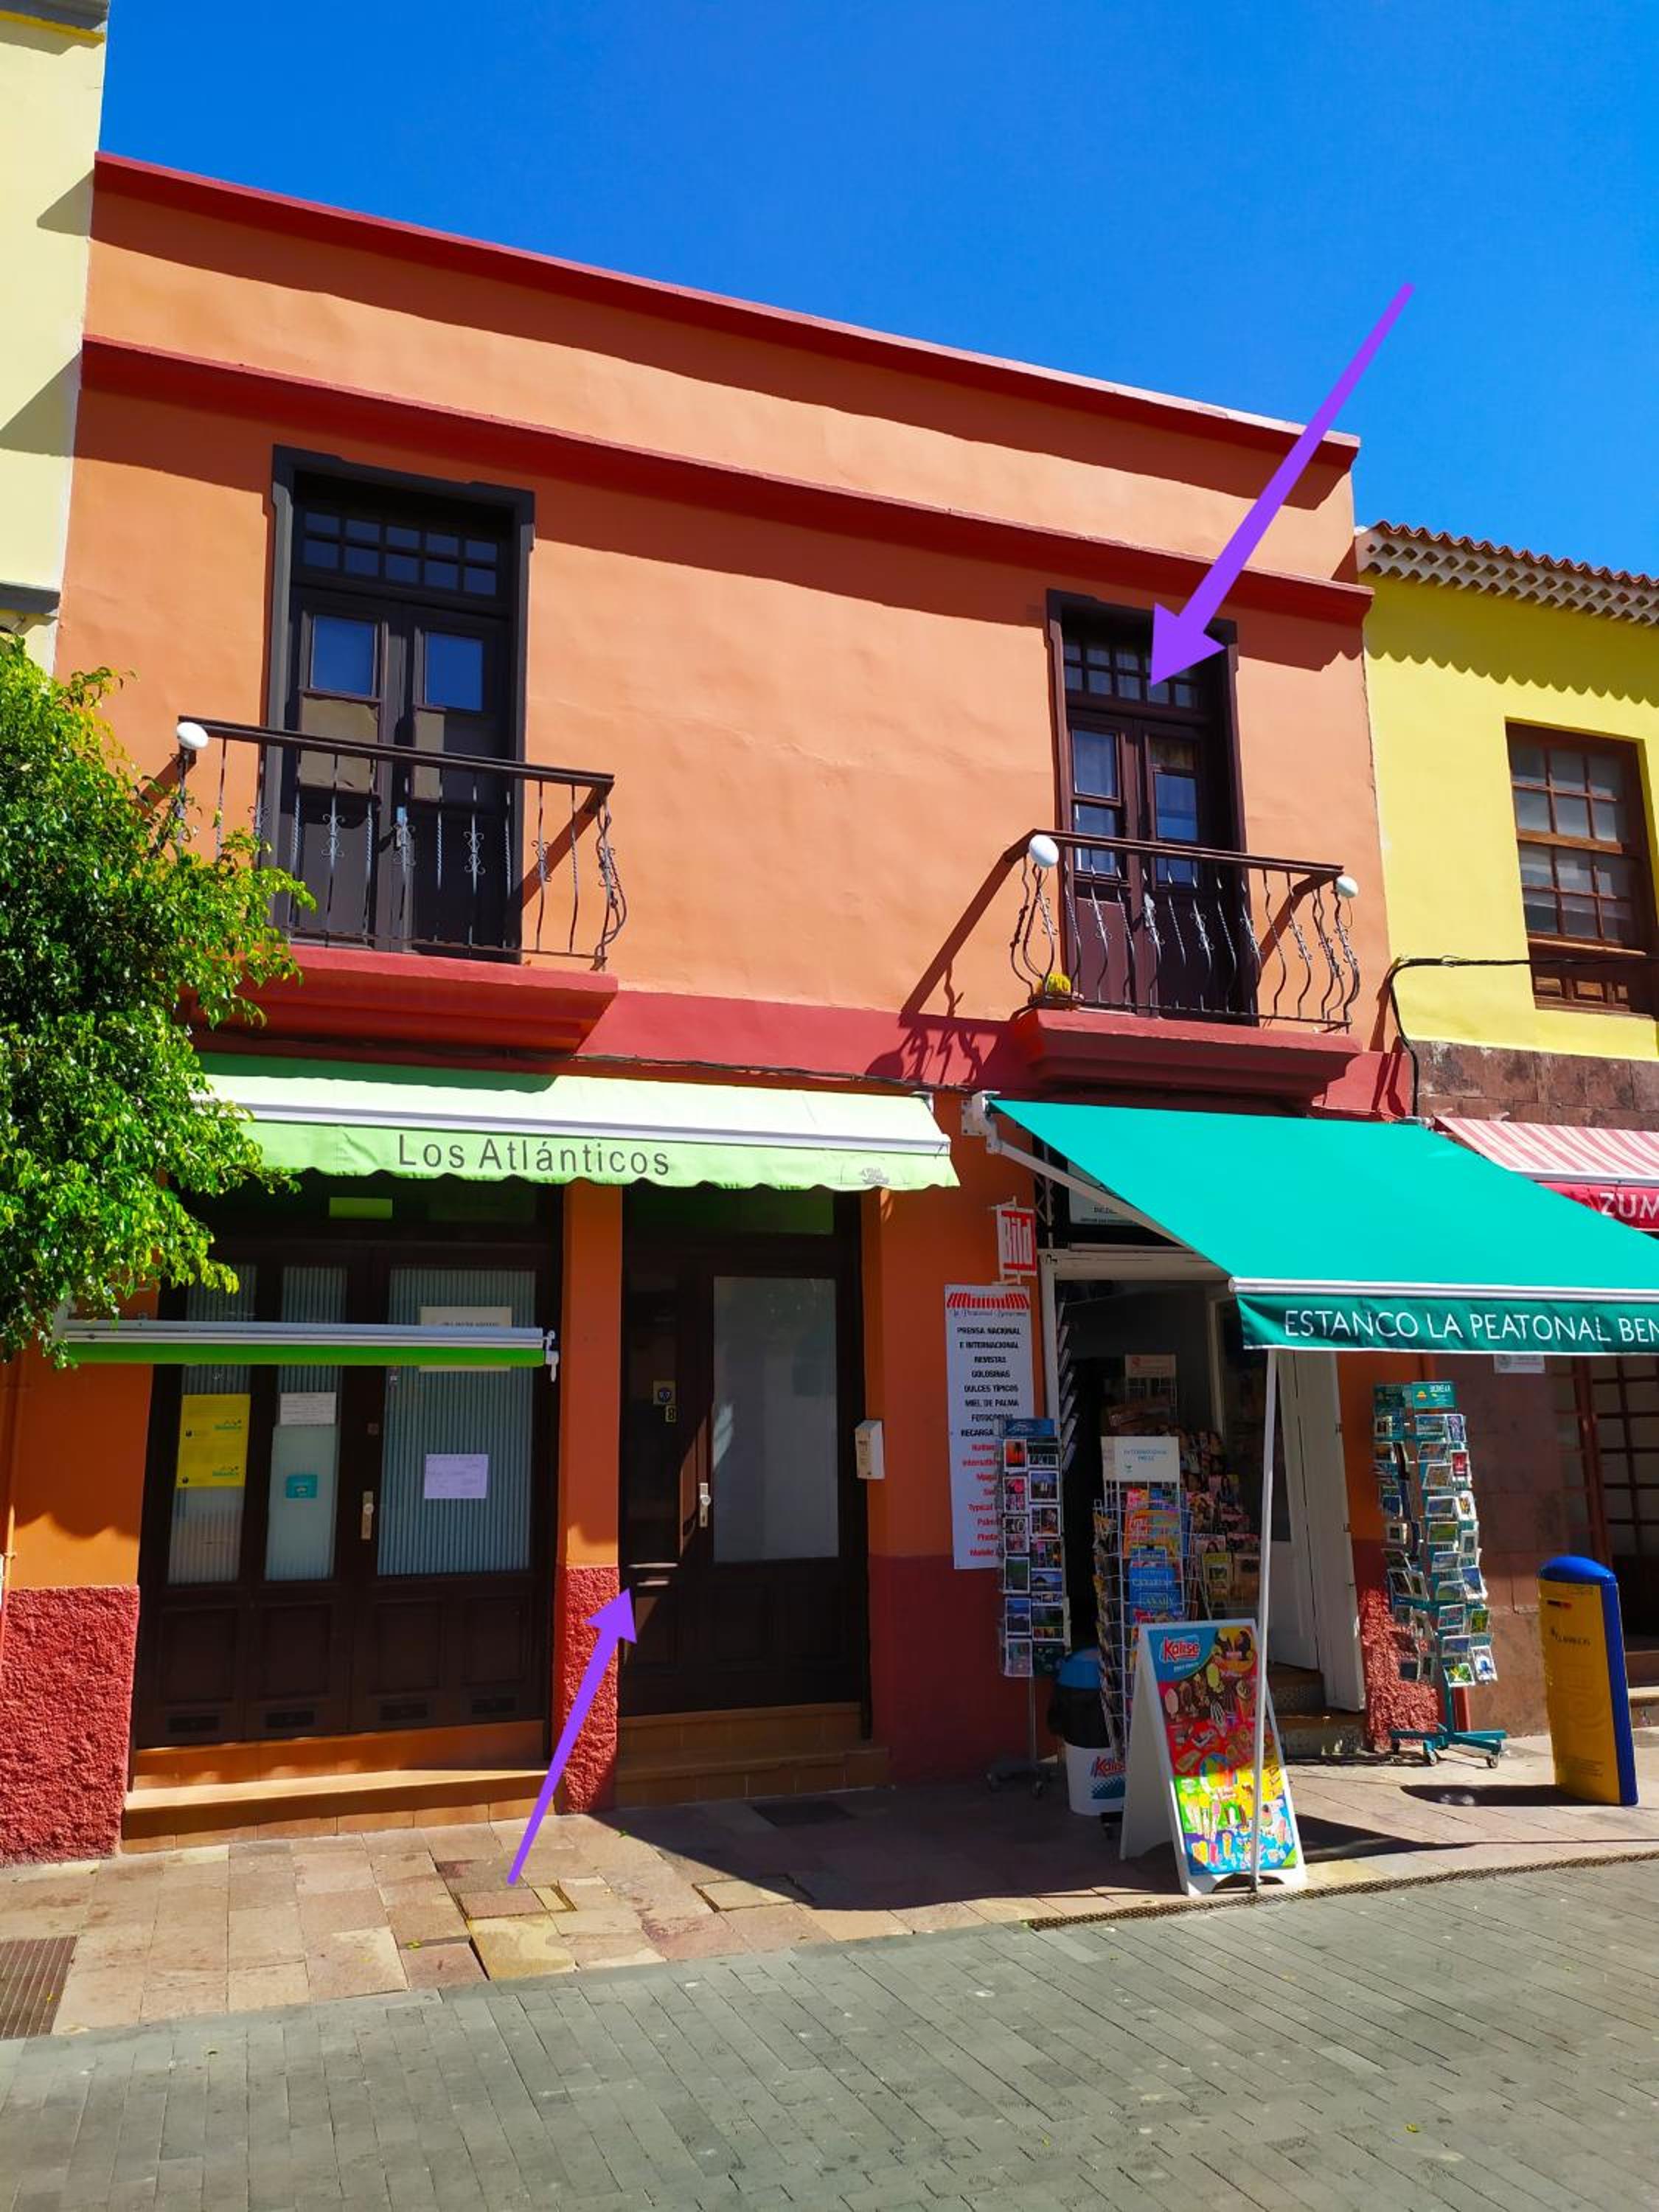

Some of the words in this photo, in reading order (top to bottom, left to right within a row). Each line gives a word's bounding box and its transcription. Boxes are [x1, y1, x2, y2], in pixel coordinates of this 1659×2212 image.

[399, 1133, 465, 1169] Los
[479, 1138, 669, 1176] Atlánticos
[1284, 1310, 1419, 1338] ESTANCO
[1427, 1313, 1463, 1339] LA
[1471, 1314, 1610, 1343] PEATONAL
[1163, 1636, 1200, 1660] Kalise
